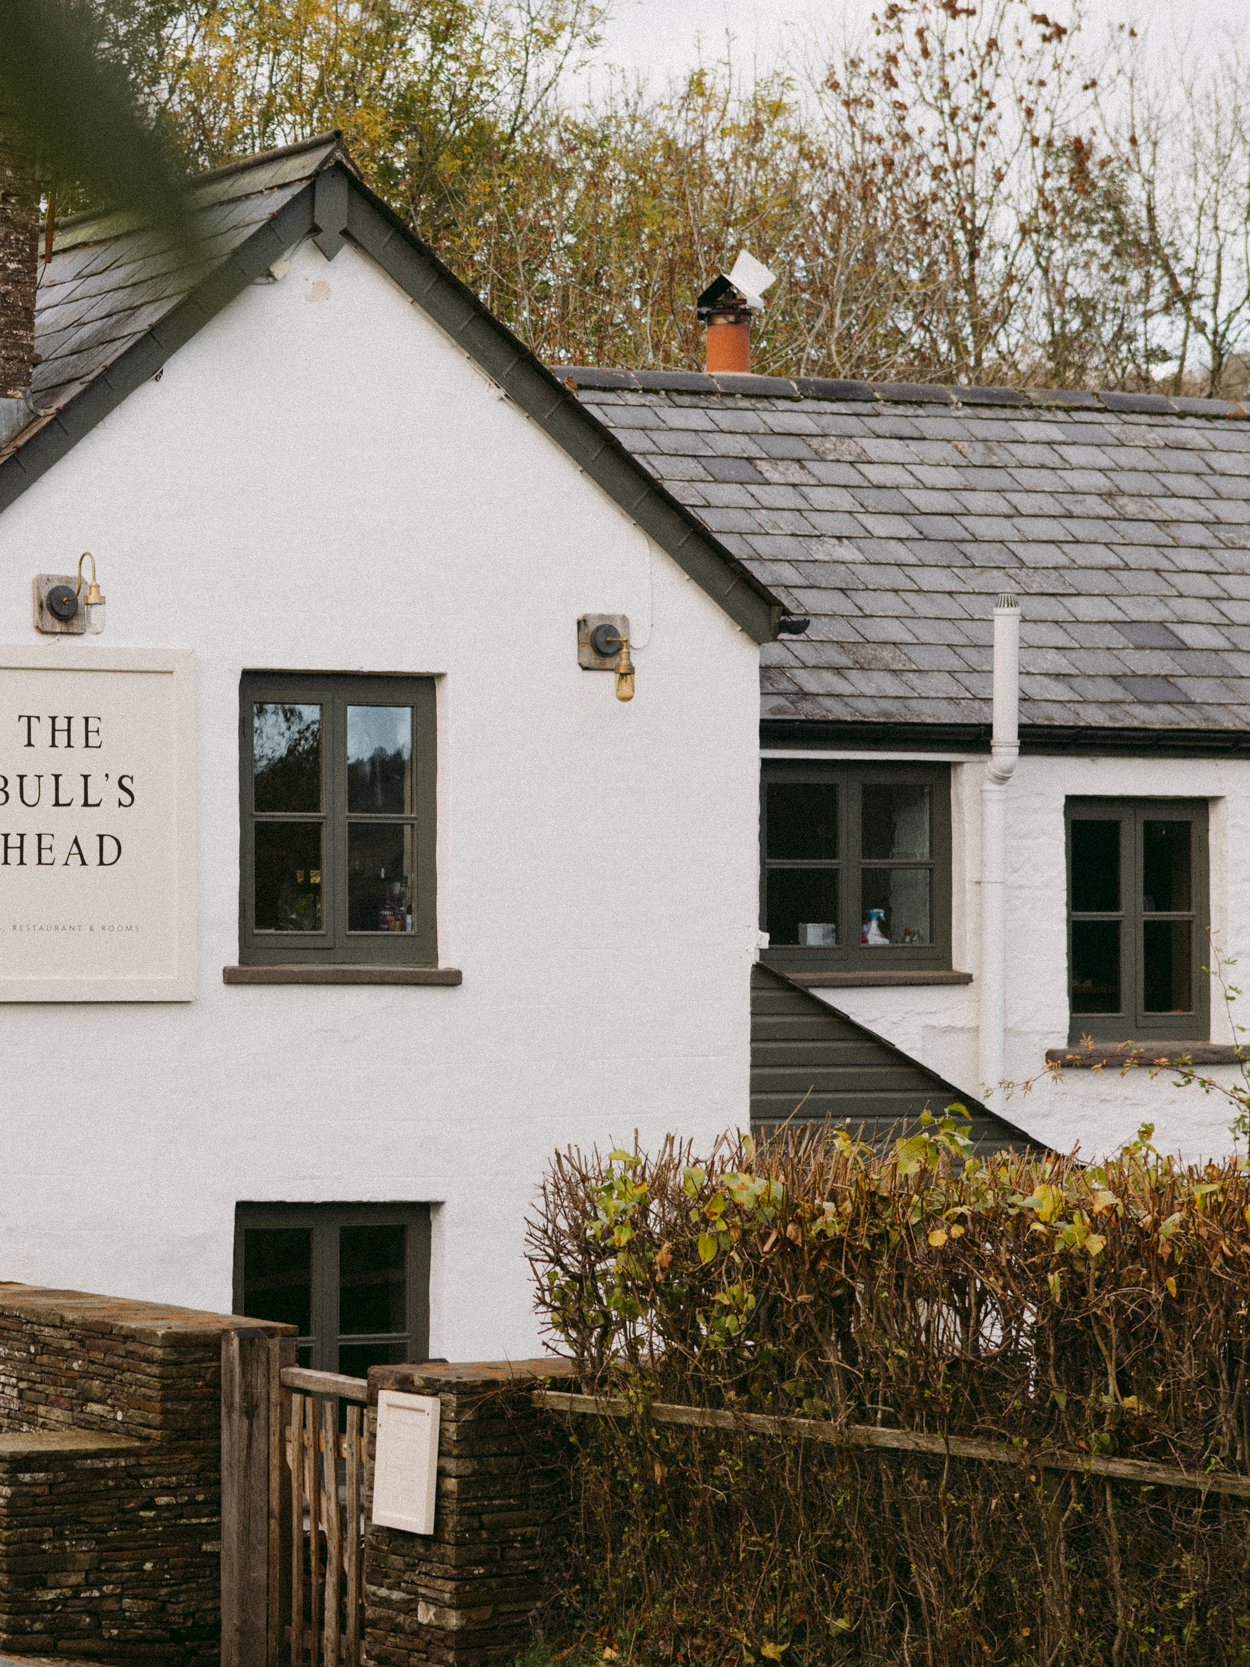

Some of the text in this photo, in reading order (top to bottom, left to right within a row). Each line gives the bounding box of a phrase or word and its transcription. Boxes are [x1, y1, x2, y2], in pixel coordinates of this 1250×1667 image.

[17, 714, 103, 749] THE
[0, 833, 123, 866] HEAD
[12, 924, 82, 933] RESTAURANT
[89, 924, 95, 933] &
[101, 924, 140, 933] ROOMS
